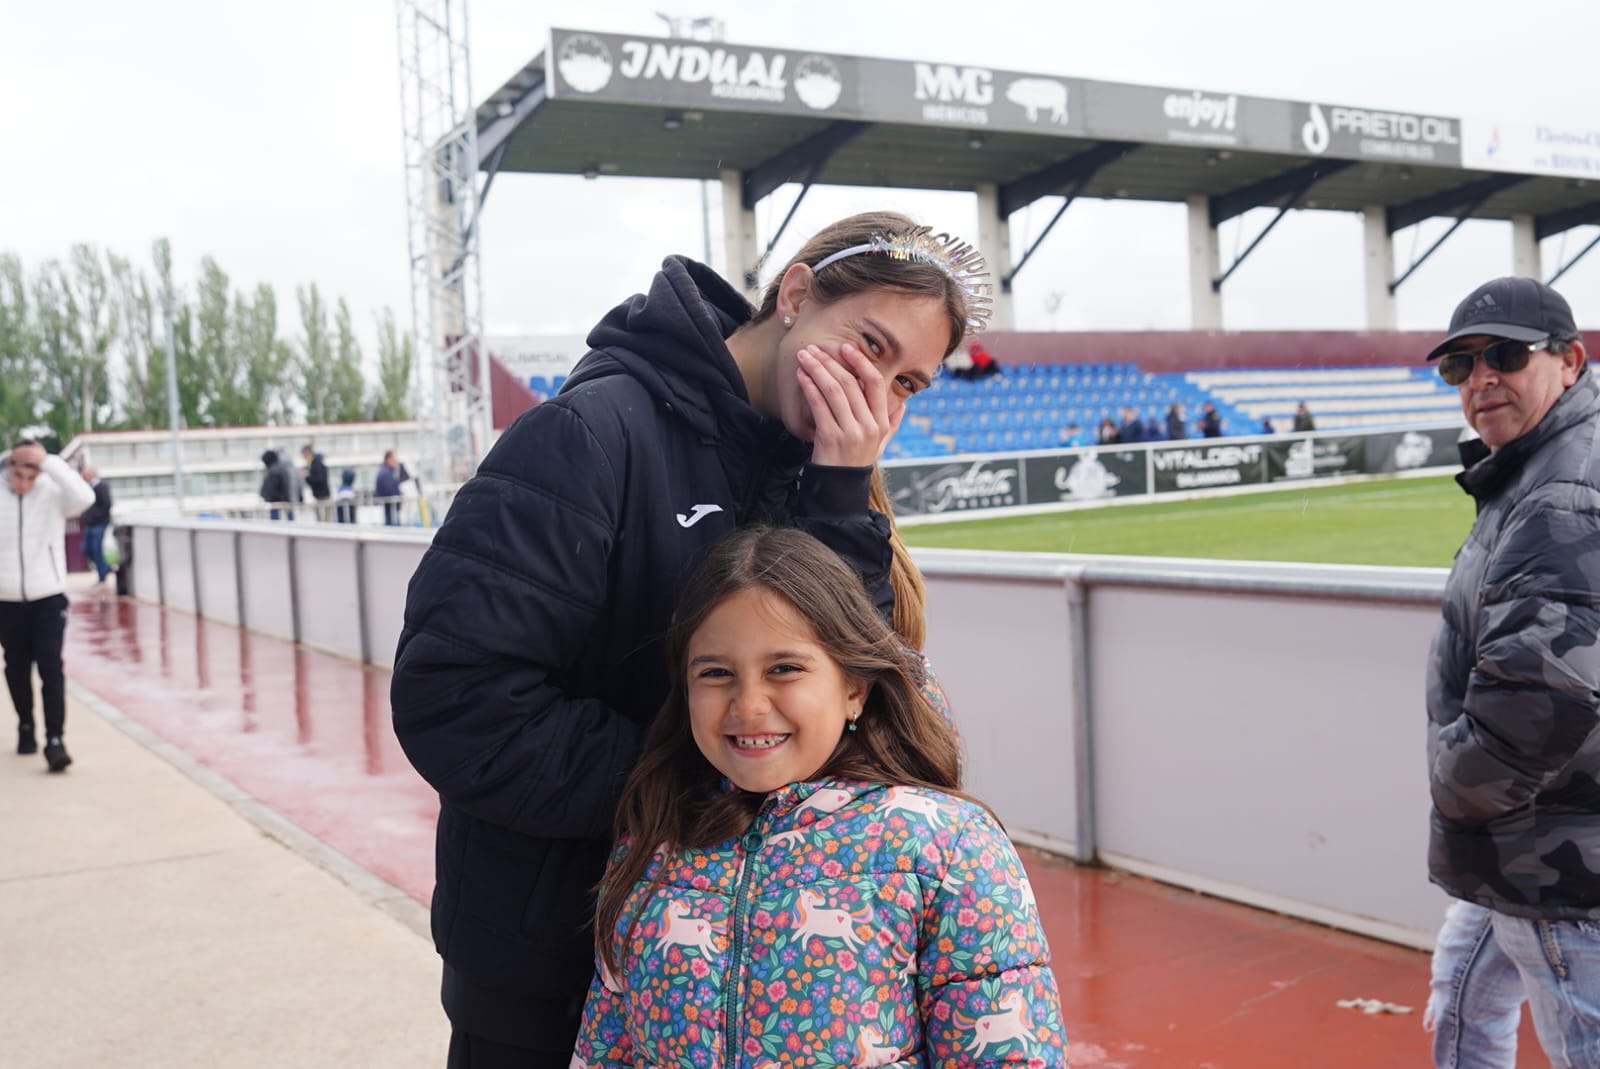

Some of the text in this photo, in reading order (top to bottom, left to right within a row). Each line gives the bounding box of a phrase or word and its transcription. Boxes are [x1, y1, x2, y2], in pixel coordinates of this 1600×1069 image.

[914, 63, 995, 105] MMG
[1163, 91, 1237, 130] enjoy!
[1153, 445, 1264, 471] VITALDENT
